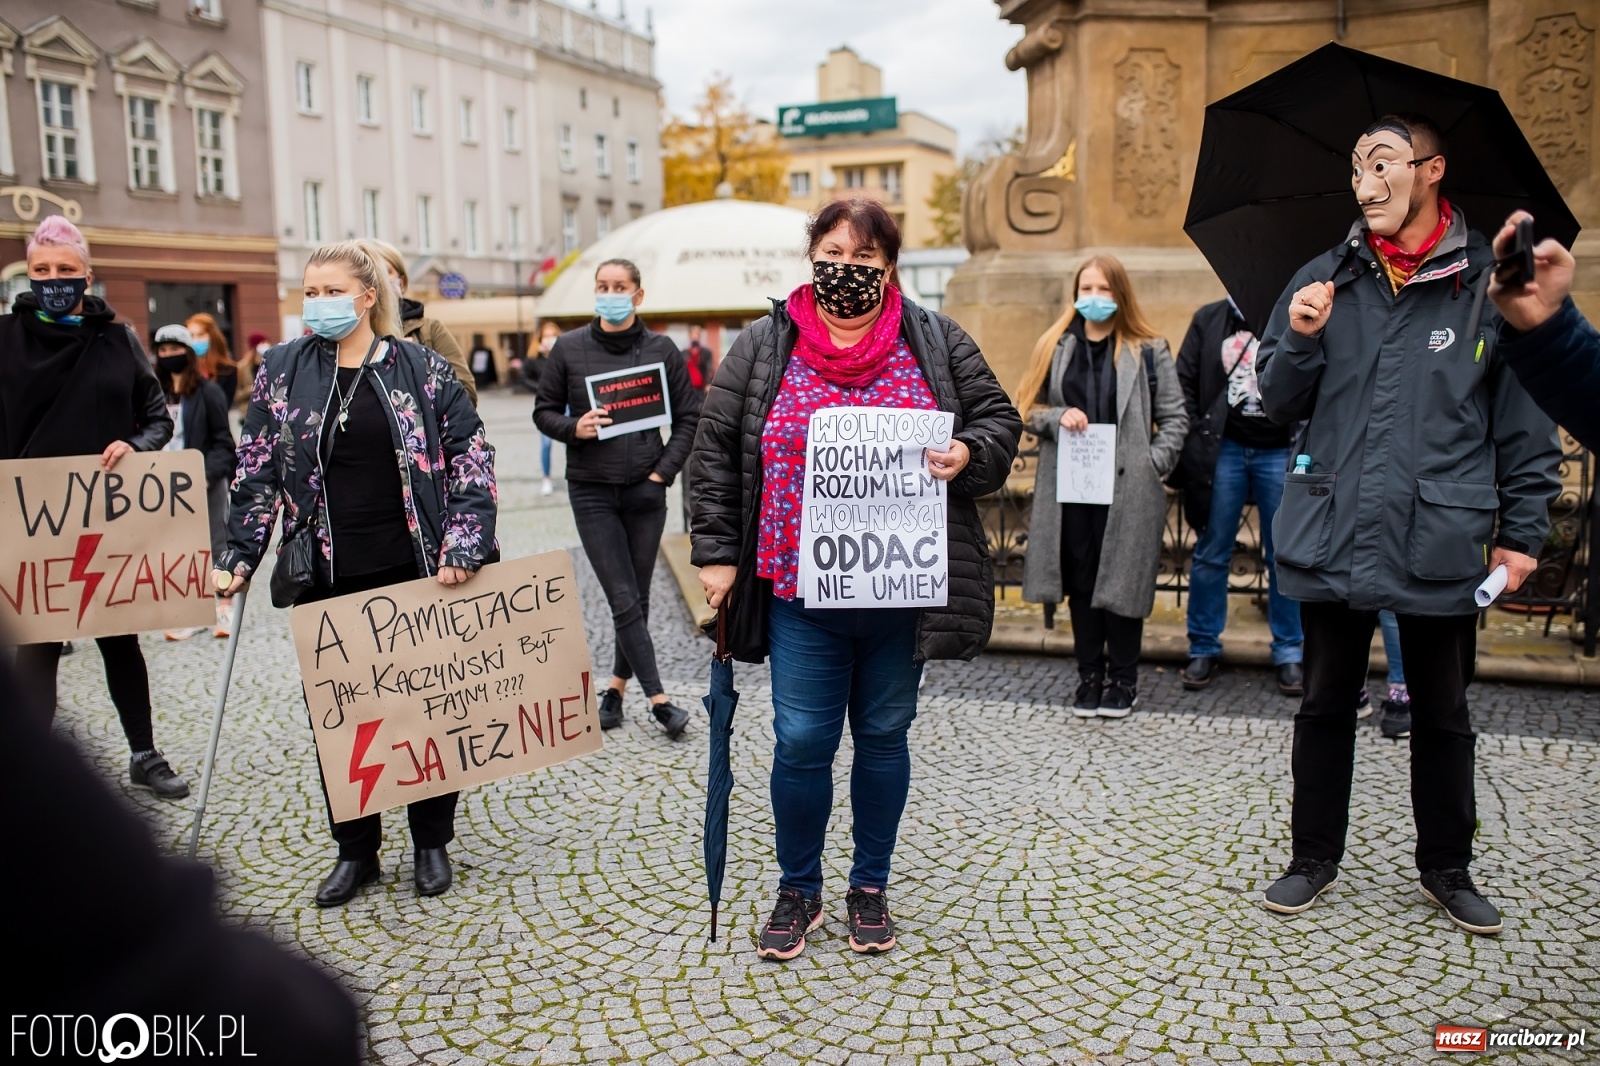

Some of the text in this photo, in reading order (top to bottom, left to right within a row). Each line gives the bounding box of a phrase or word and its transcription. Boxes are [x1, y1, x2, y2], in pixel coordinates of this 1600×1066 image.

[598, 376, 653, 394] ZAPRASZAMY
[812, 444, 904, 472] KOCHAM
[14, 463, 195, 537] WYBÓR
[812, 472, 940, 499] ROZUMIEM
[809, 500, 945, 533] WOLNOŚCI
[813, 530, 939, 573] ODDAĆ
[105, 550, 215, 607] ZAKAZ
[817, 572, 946, 602] NIE UMIEM
[315, 611, 349, 669] A
[315, 679, 369, 729] JAK
[423, 683, 487, 720] FAJNY
[392, 671, 592, 786] JA TEŻ NIE!
